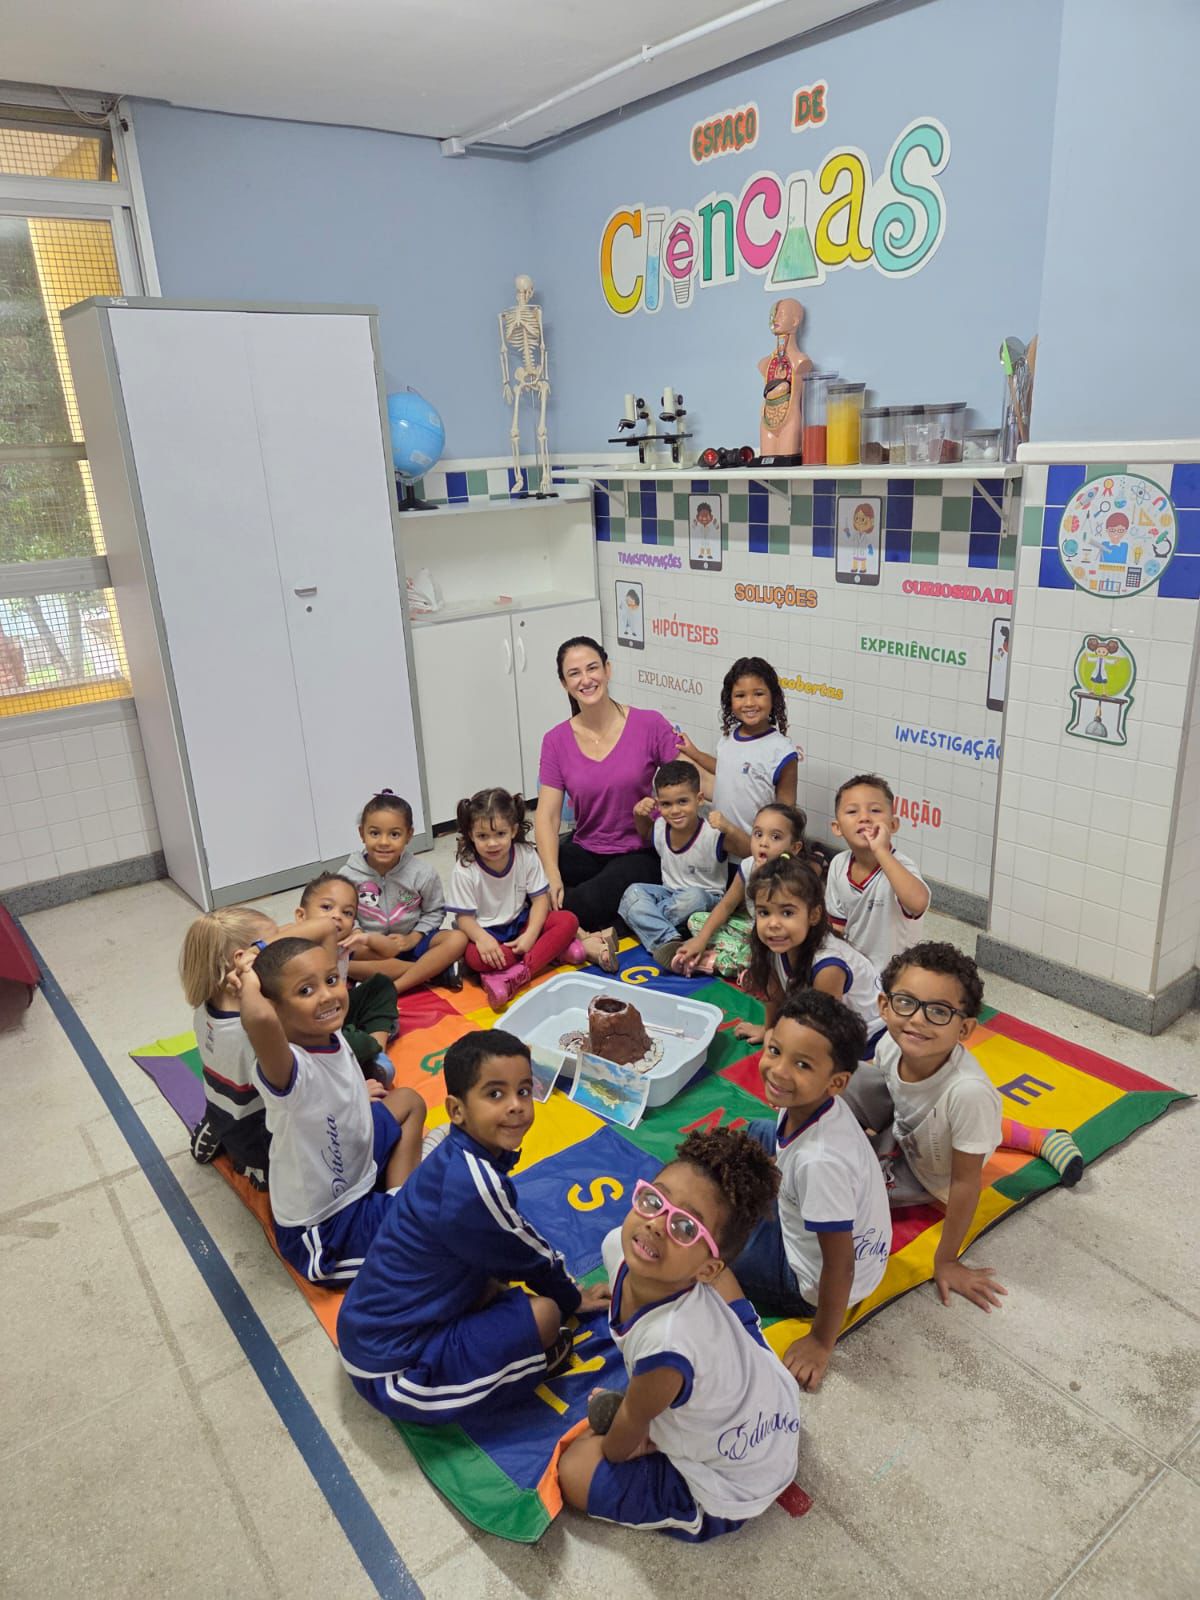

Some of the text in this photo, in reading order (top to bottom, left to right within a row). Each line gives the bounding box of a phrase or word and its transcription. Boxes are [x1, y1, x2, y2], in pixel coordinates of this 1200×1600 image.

[692, 84, 826, 162] ESPAÇO DE
[617, 551, 682, 571] TRANSFORMAÇÕES
[734, 582, 818, 609] SOLUÇÕES
[652, 613, 719, 646] HIPÓTESES
[860, 636, 967, 667] EXPERIÊNCIAS
[638, 669, 703, 696] EXPLORAÇÃO
[778, 674, 844, 701] cobertas
[892, 796, 942, 829] VAÇÃO
[996, 1072, 1056, 1107] E
[321, 1113, 349, 1200] Vitória
[567, 1176, 625, 1213] S
